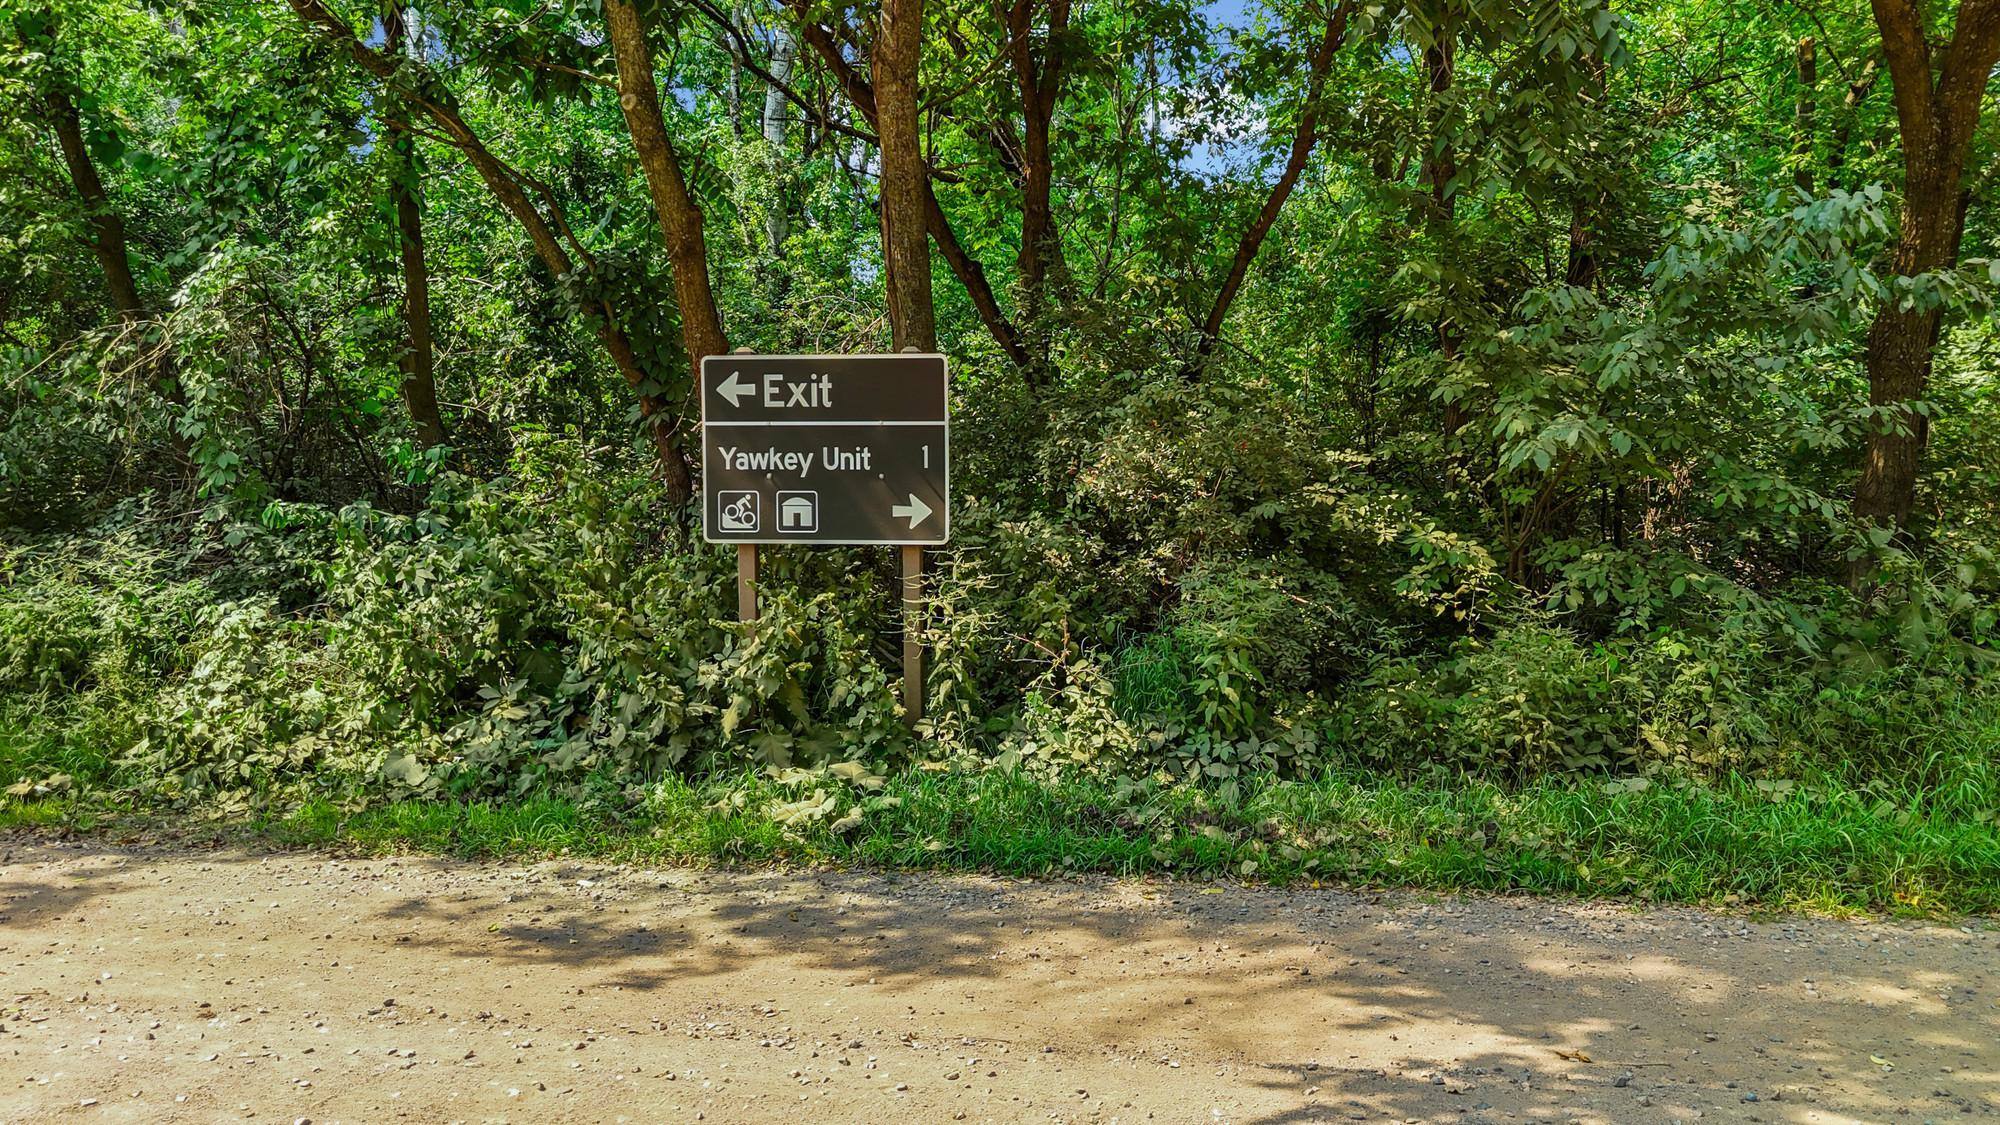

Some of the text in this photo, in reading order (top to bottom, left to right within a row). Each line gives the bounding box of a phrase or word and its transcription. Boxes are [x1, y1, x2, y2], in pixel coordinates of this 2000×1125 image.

[763, 373, 833, 408] Exit
[718, 445, 929, 478] Yawkey Unit 1
